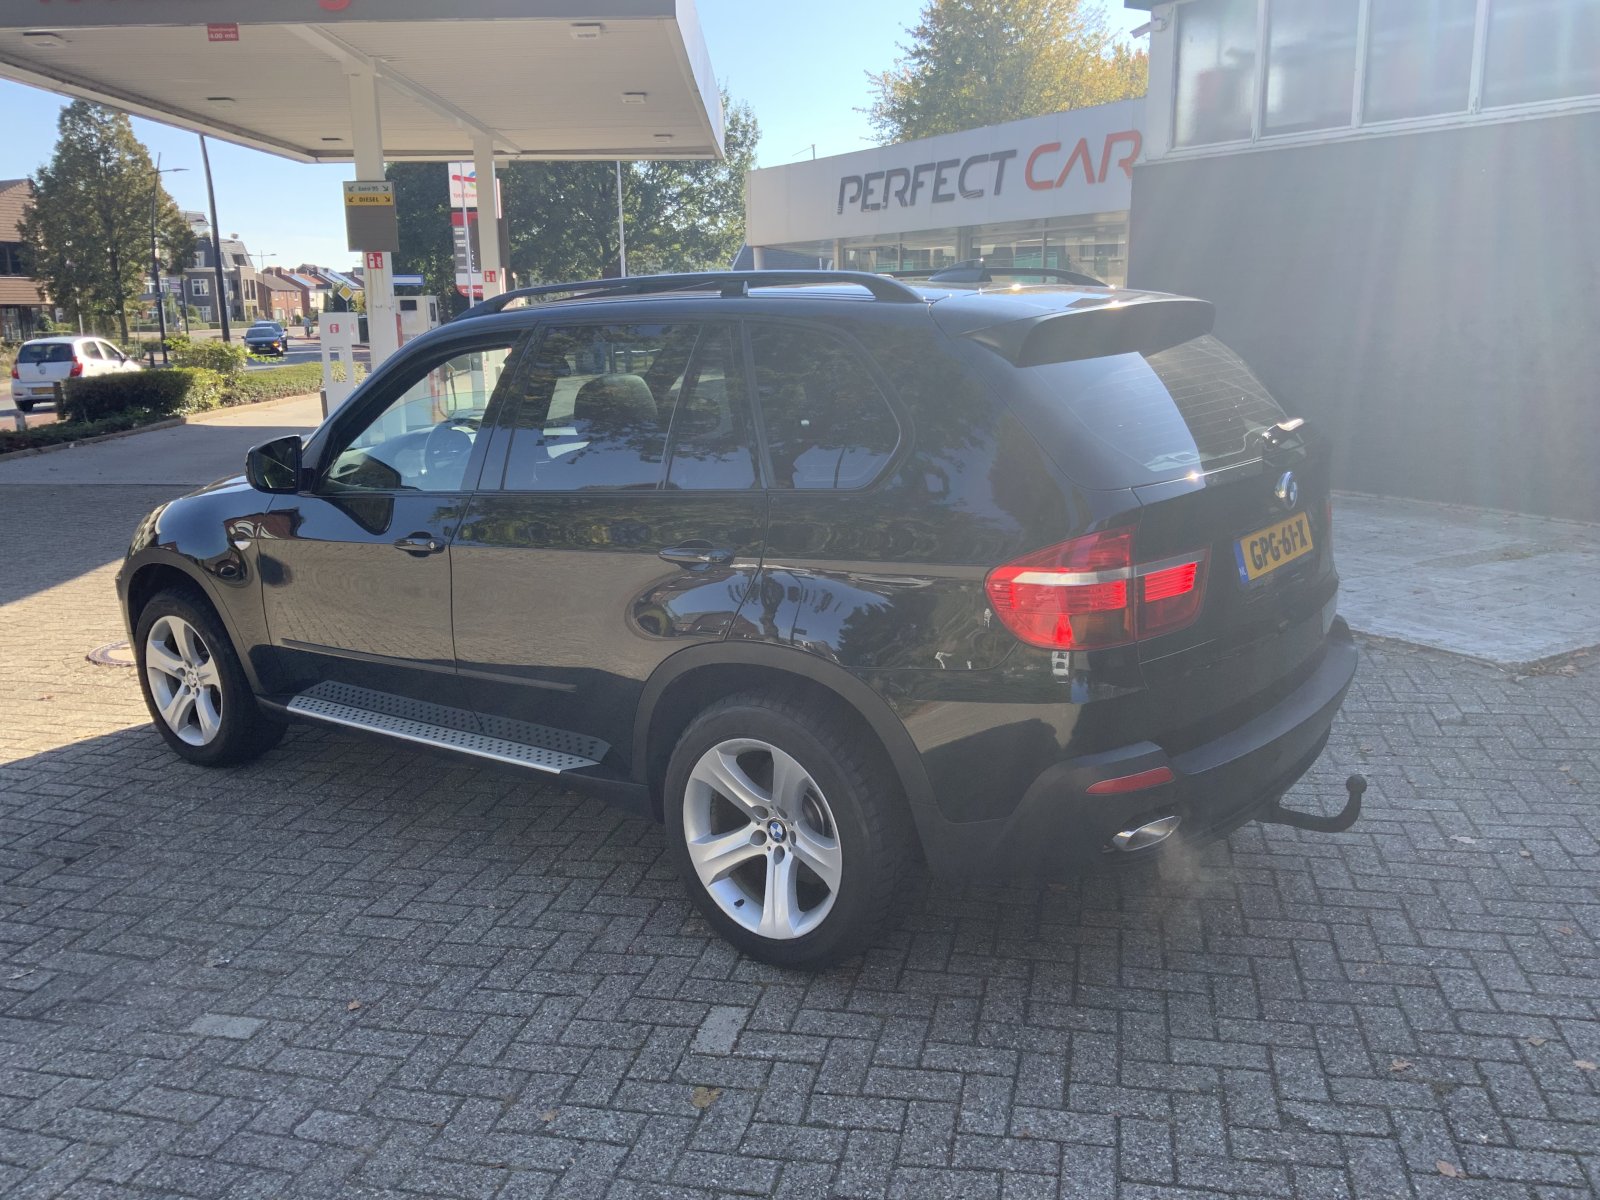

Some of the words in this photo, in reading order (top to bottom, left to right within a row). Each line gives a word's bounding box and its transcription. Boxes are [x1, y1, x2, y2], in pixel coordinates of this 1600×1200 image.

[837, 149, 1017, 215] PERFECT
[1024, 129, 1142, 191] CAR
[1249, 519, 1308, 570] GPG-61-X
